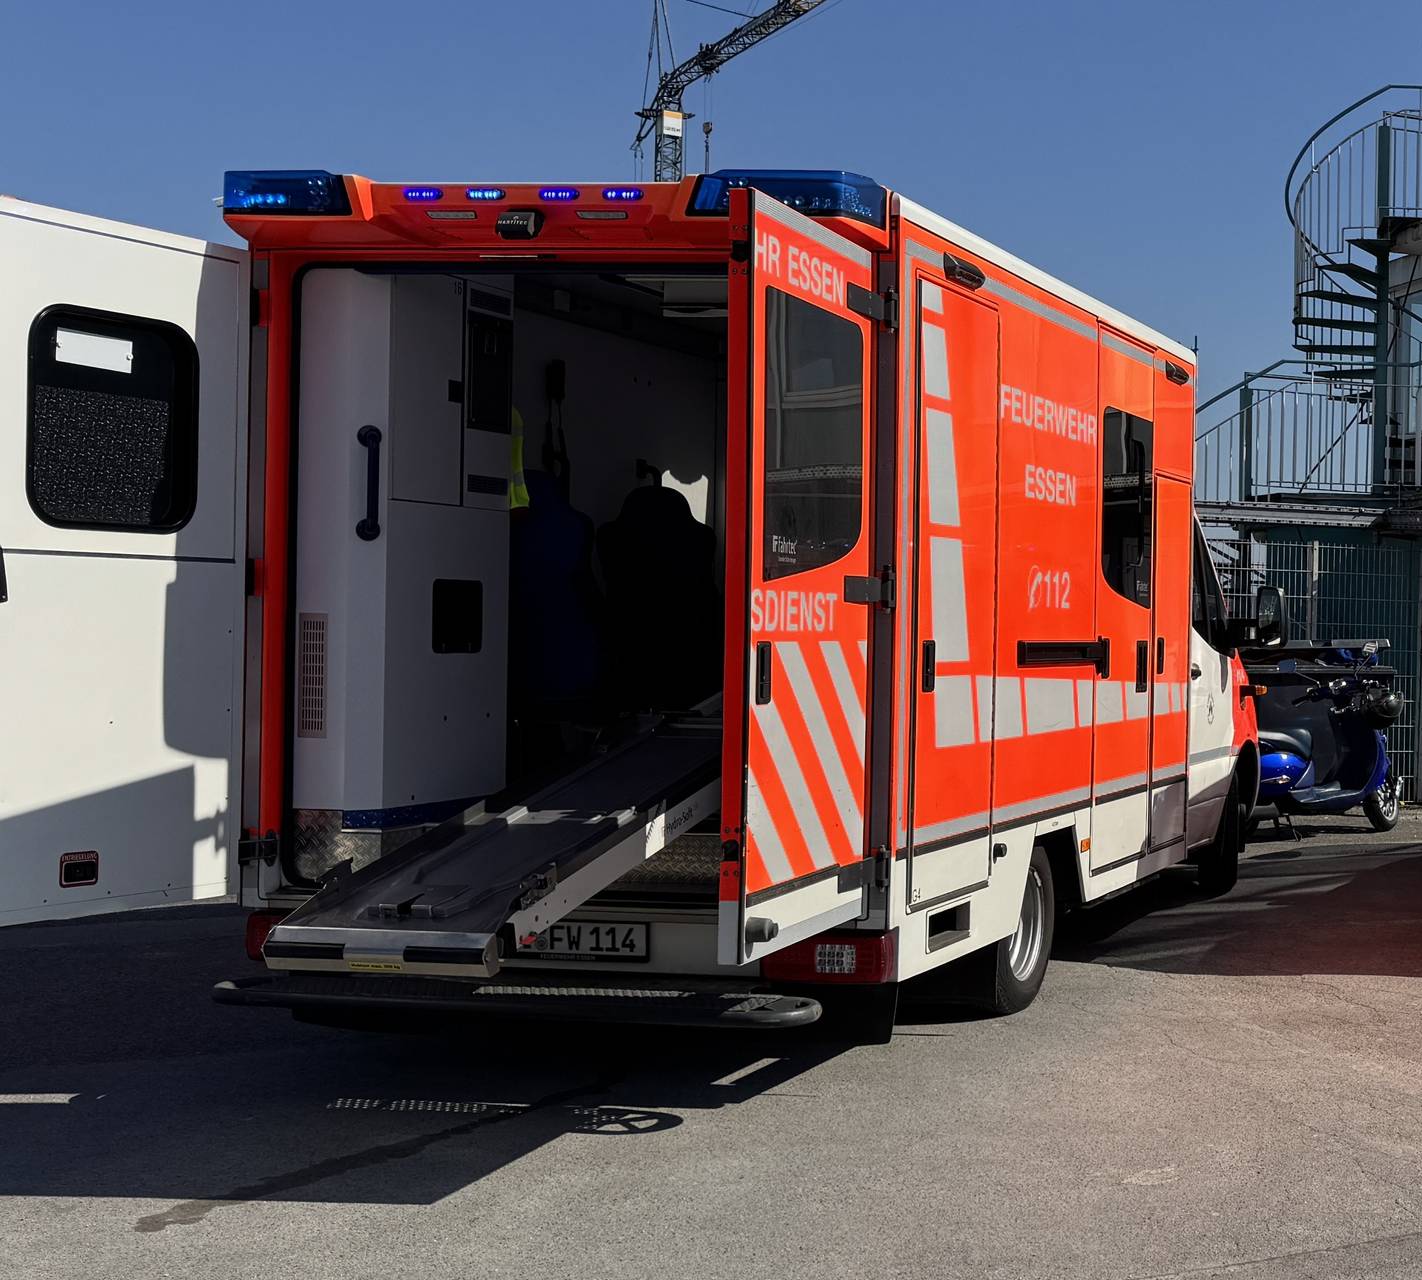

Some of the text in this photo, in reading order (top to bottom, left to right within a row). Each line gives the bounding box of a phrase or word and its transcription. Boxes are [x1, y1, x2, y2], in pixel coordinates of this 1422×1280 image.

[788, 245, 845, 306] ESSEN
[1000, 383, 1098, 447] FEUERWEHR
[1025, 464, 1077, 507] ESSEN
[751, 588, 838, 632] SDIENST
[1044, 569, 1071, 609] 112
[549, 925, 637, 952] FW 114
